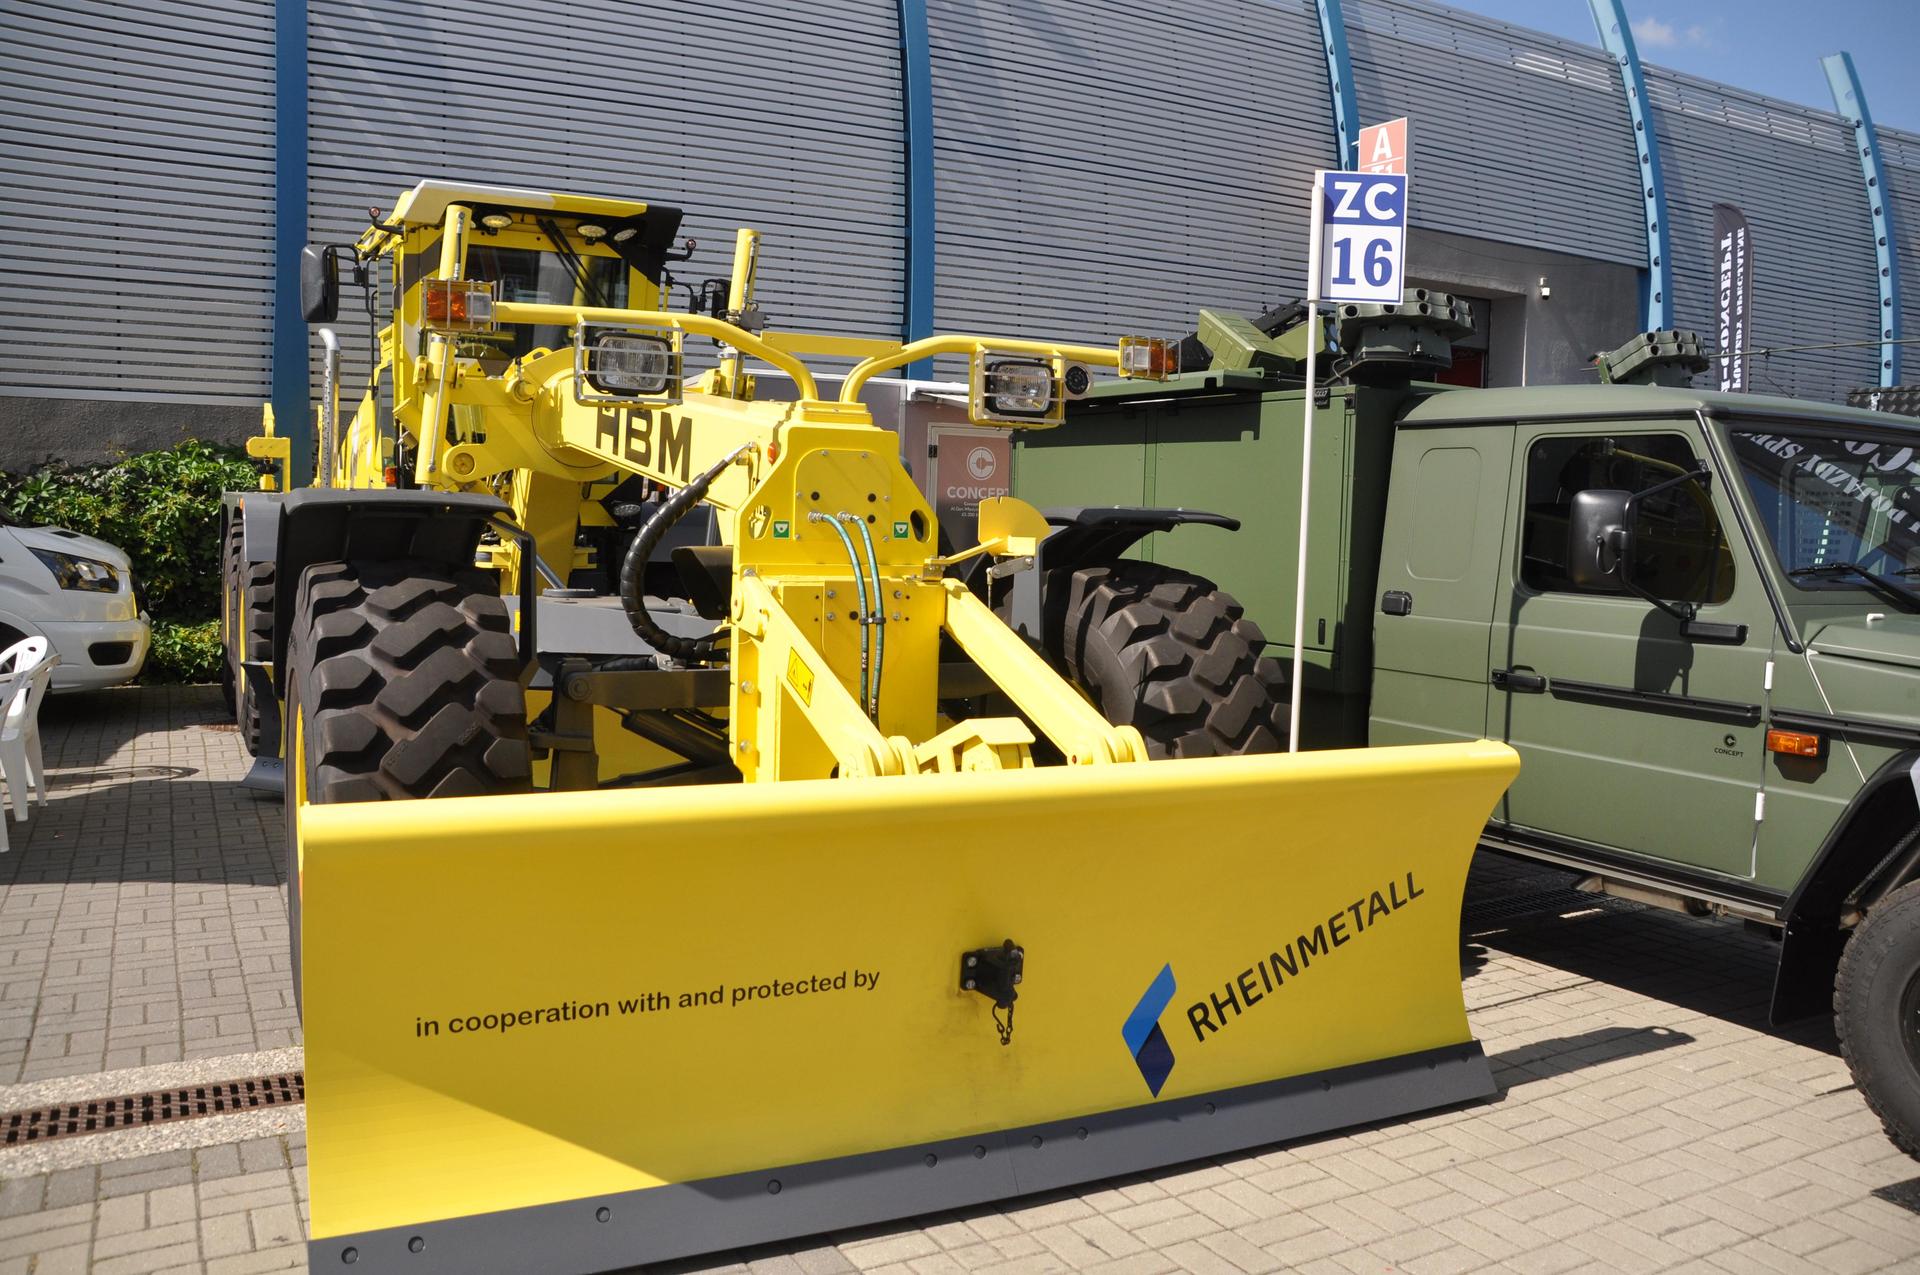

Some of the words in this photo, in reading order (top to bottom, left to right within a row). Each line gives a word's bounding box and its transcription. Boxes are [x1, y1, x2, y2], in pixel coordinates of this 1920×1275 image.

[1371, 126, 1393, 163] A
[1333, 181, 1398, 220] ZC
[1332, 237, 1393, 287] 16
[596, 400, 693, 484] HBM
[1714, 747, 1744, 757] CONCEPT
[1186, 871, 1425, 1042] RHEINMETALL
[415, 1017, 439, 1037] in
[448, 1000, 610, 1033] cooperation
[617, 992, 670, 1014] with
[678, 985, 724, 1008] and
[732, 971, 847, 1006] protected
[854, 969, 880, 990] by
